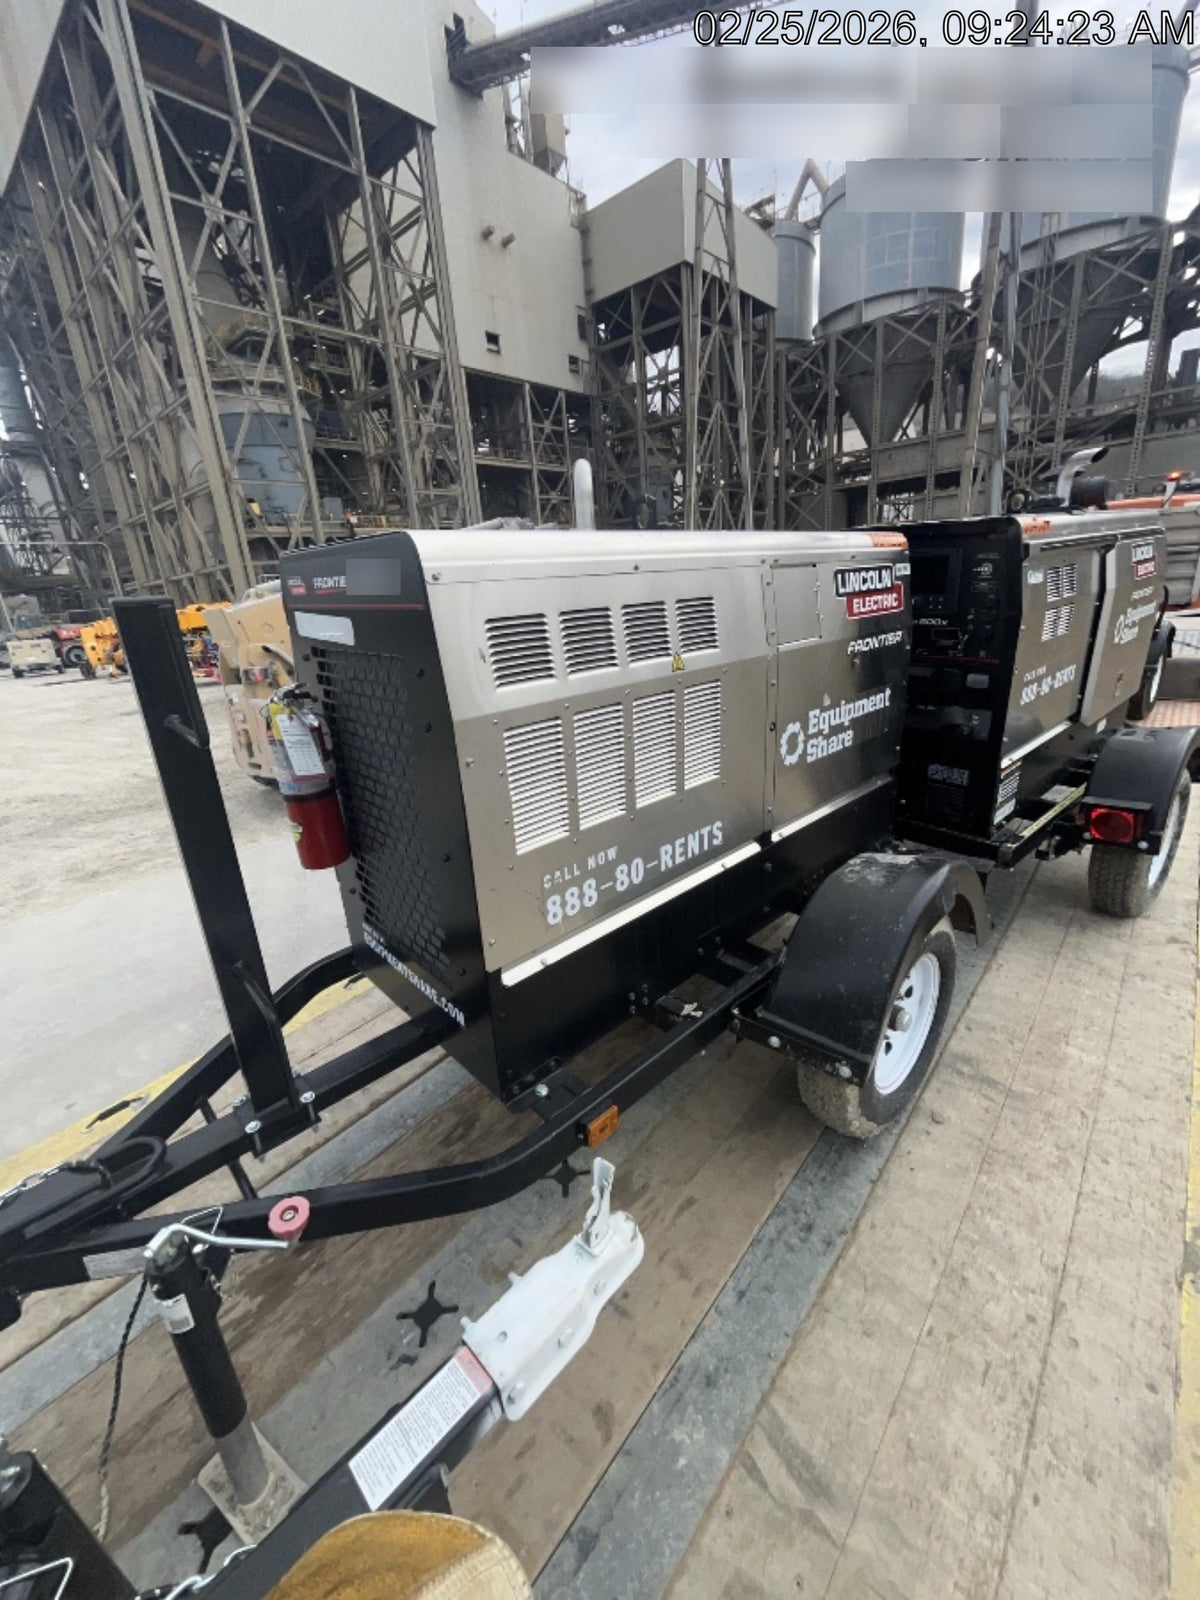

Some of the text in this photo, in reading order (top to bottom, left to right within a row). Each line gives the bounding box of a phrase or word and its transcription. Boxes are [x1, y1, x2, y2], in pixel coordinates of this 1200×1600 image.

[313, 575, 347, 589] FRONTIE
[836, 569, 892, 594] LINCOLN
[852, 593, 899, 614] ELECTRIC
[847, 631, 904, 654] FRONTIER
[807, 687, 892, 735] Equipment
[806, 730, 854, 763] Share
[543, 845, 619, 889] CALL NOW
[546, 820, 724, 926] 888-80-RENTS
